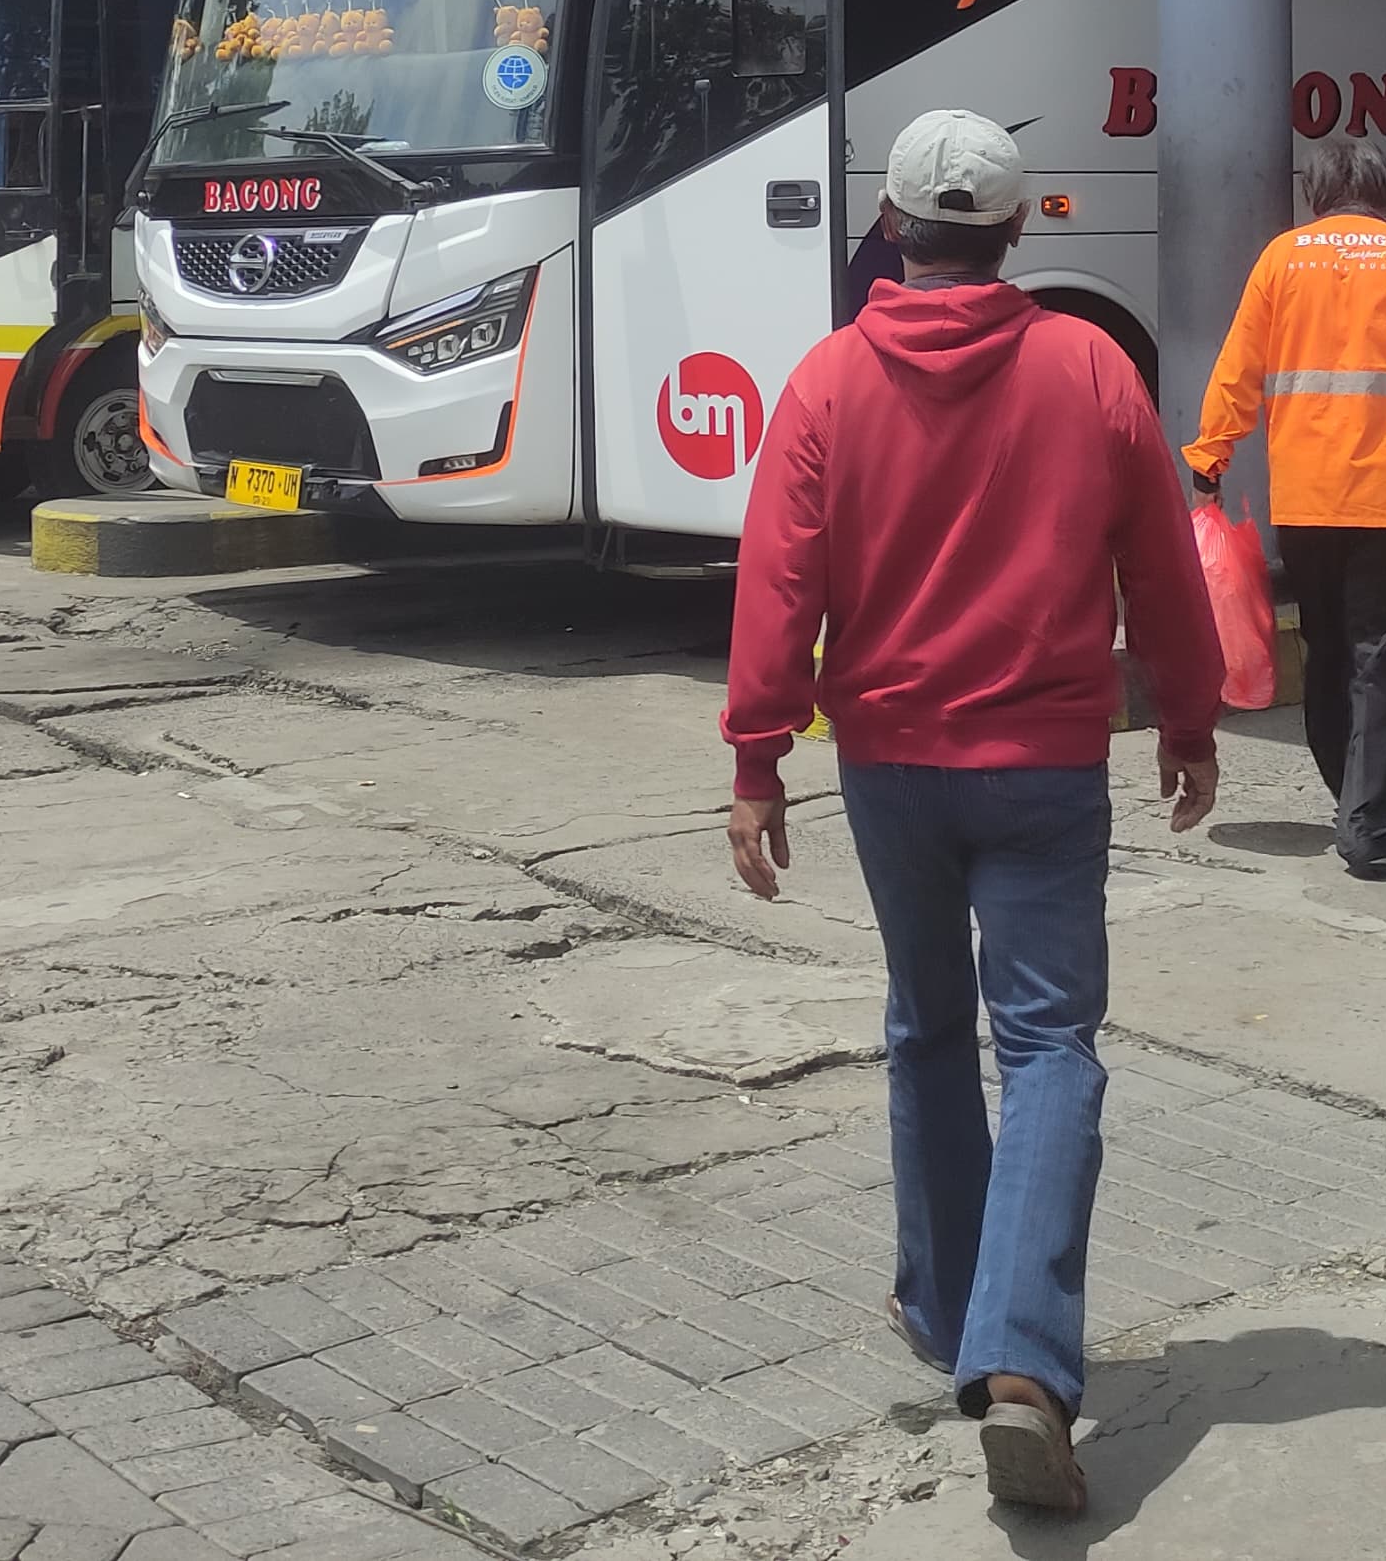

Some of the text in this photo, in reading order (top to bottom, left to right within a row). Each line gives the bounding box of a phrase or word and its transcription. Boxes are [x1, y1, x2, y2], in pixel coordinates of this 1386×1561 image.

[203, 177, 323, 213] BAGONG
[1287, 261, 1350, 271] RENTAL
[229, 465, 239, 490] N
[283, 472, 299, 498] UH
